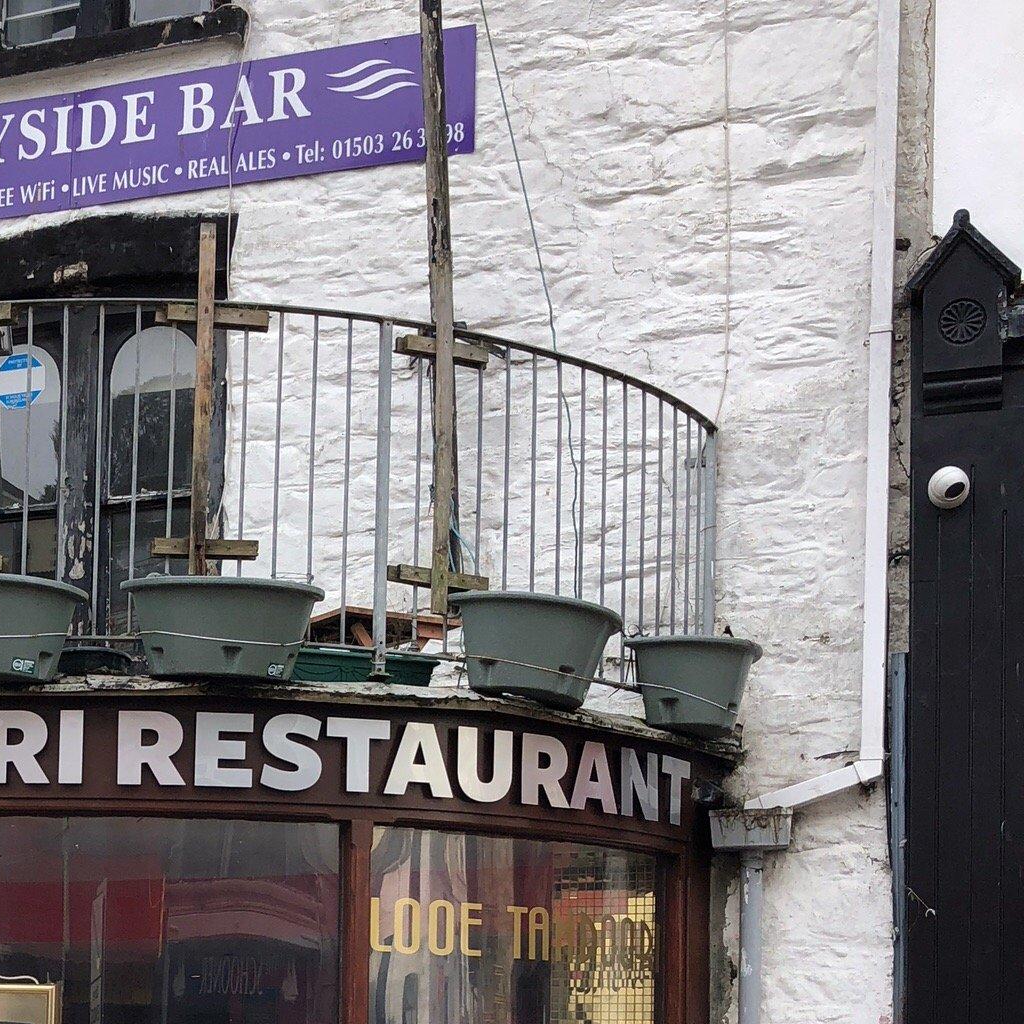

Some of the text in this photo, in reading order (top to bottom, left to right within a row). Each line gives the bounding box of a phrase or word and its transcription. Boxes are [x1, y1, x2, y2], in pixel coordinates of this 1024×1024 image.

[178, 67, 313, 137] BAR
[20, 181, 56, 207] WiFi
[72, 174, 108, 198] LIVE
[112, 164, 169, 193] MUSIC
[186, 154, 229, 180] REAL
[233, 147, 277, 173] ALES
[295, 137, 325, 166] Tel:
[331, 134, 384, 162] 01503
[116, 709, 693, 828] RESTAURANT
[370, 897, 482, 957] LOOE
